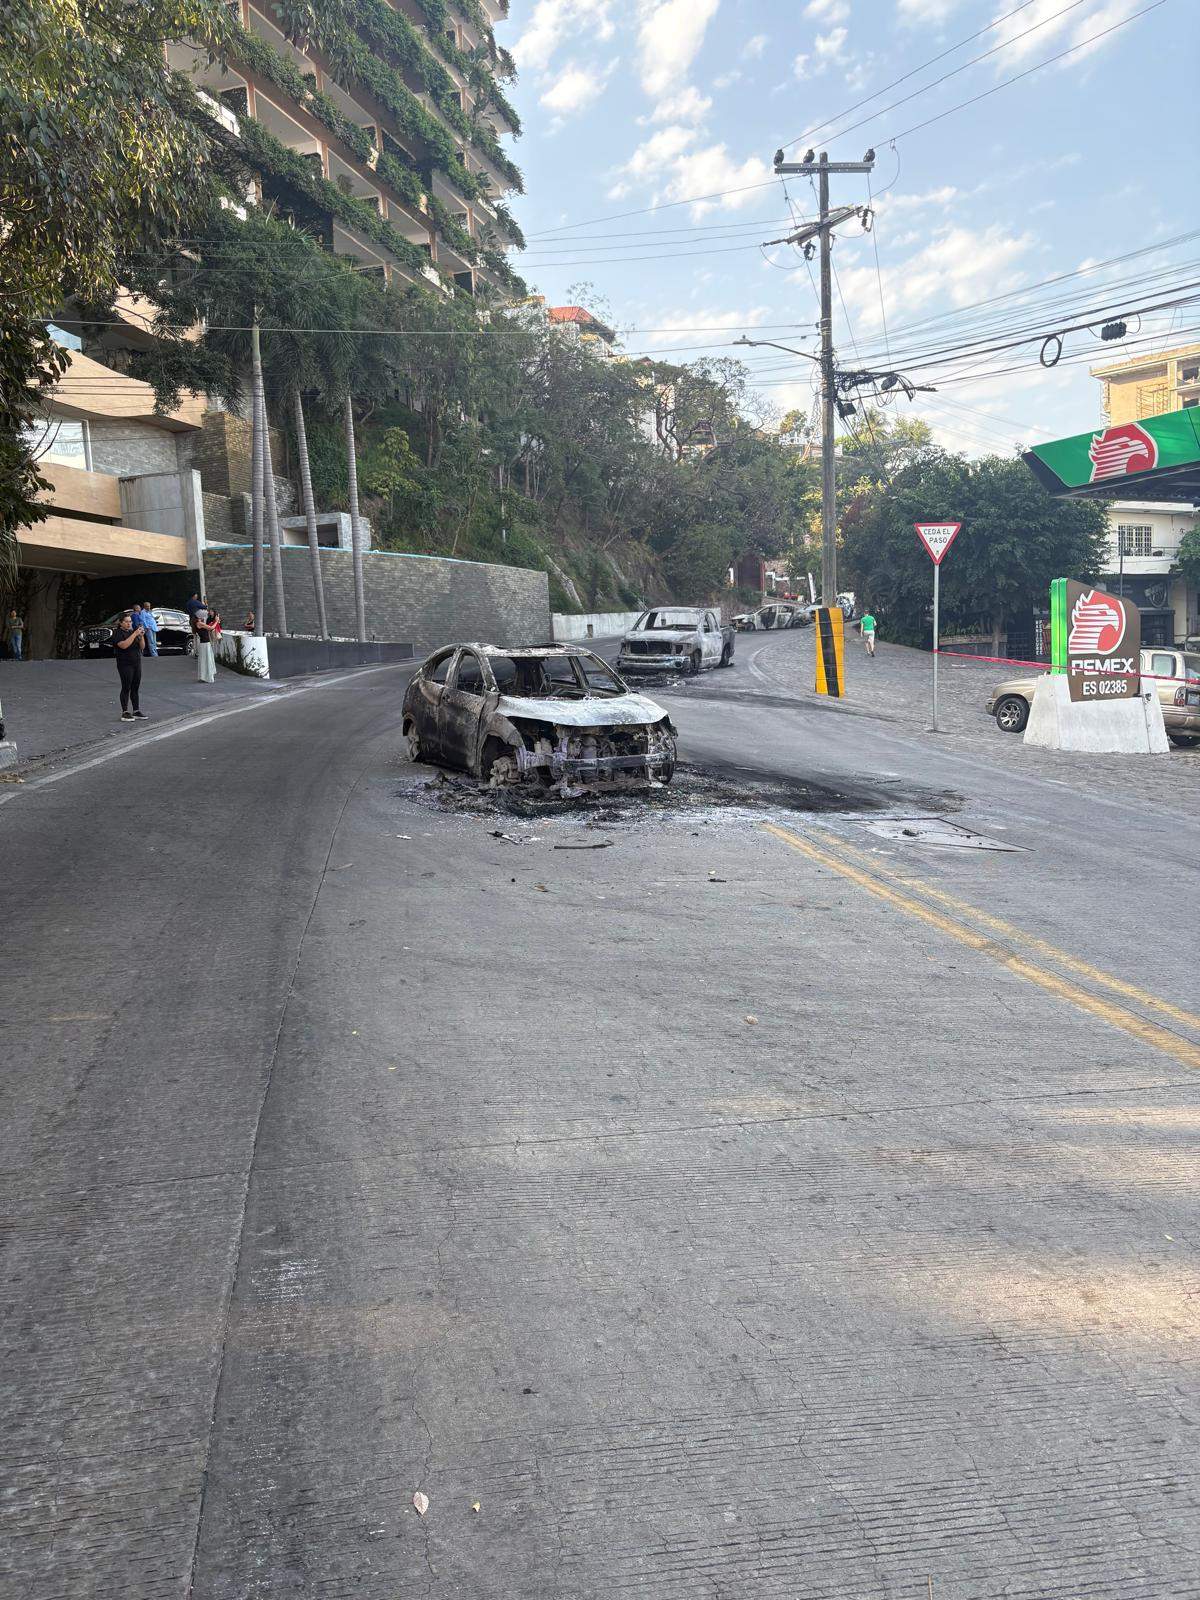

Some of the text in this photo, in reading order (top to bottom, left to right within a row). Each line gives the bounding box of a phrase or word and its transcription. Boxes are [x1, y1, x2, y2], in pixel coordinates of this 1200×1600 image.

[1071, 658, 1134, 676] PEMEX
[1083, 680, 1128, 696] ES 02385
